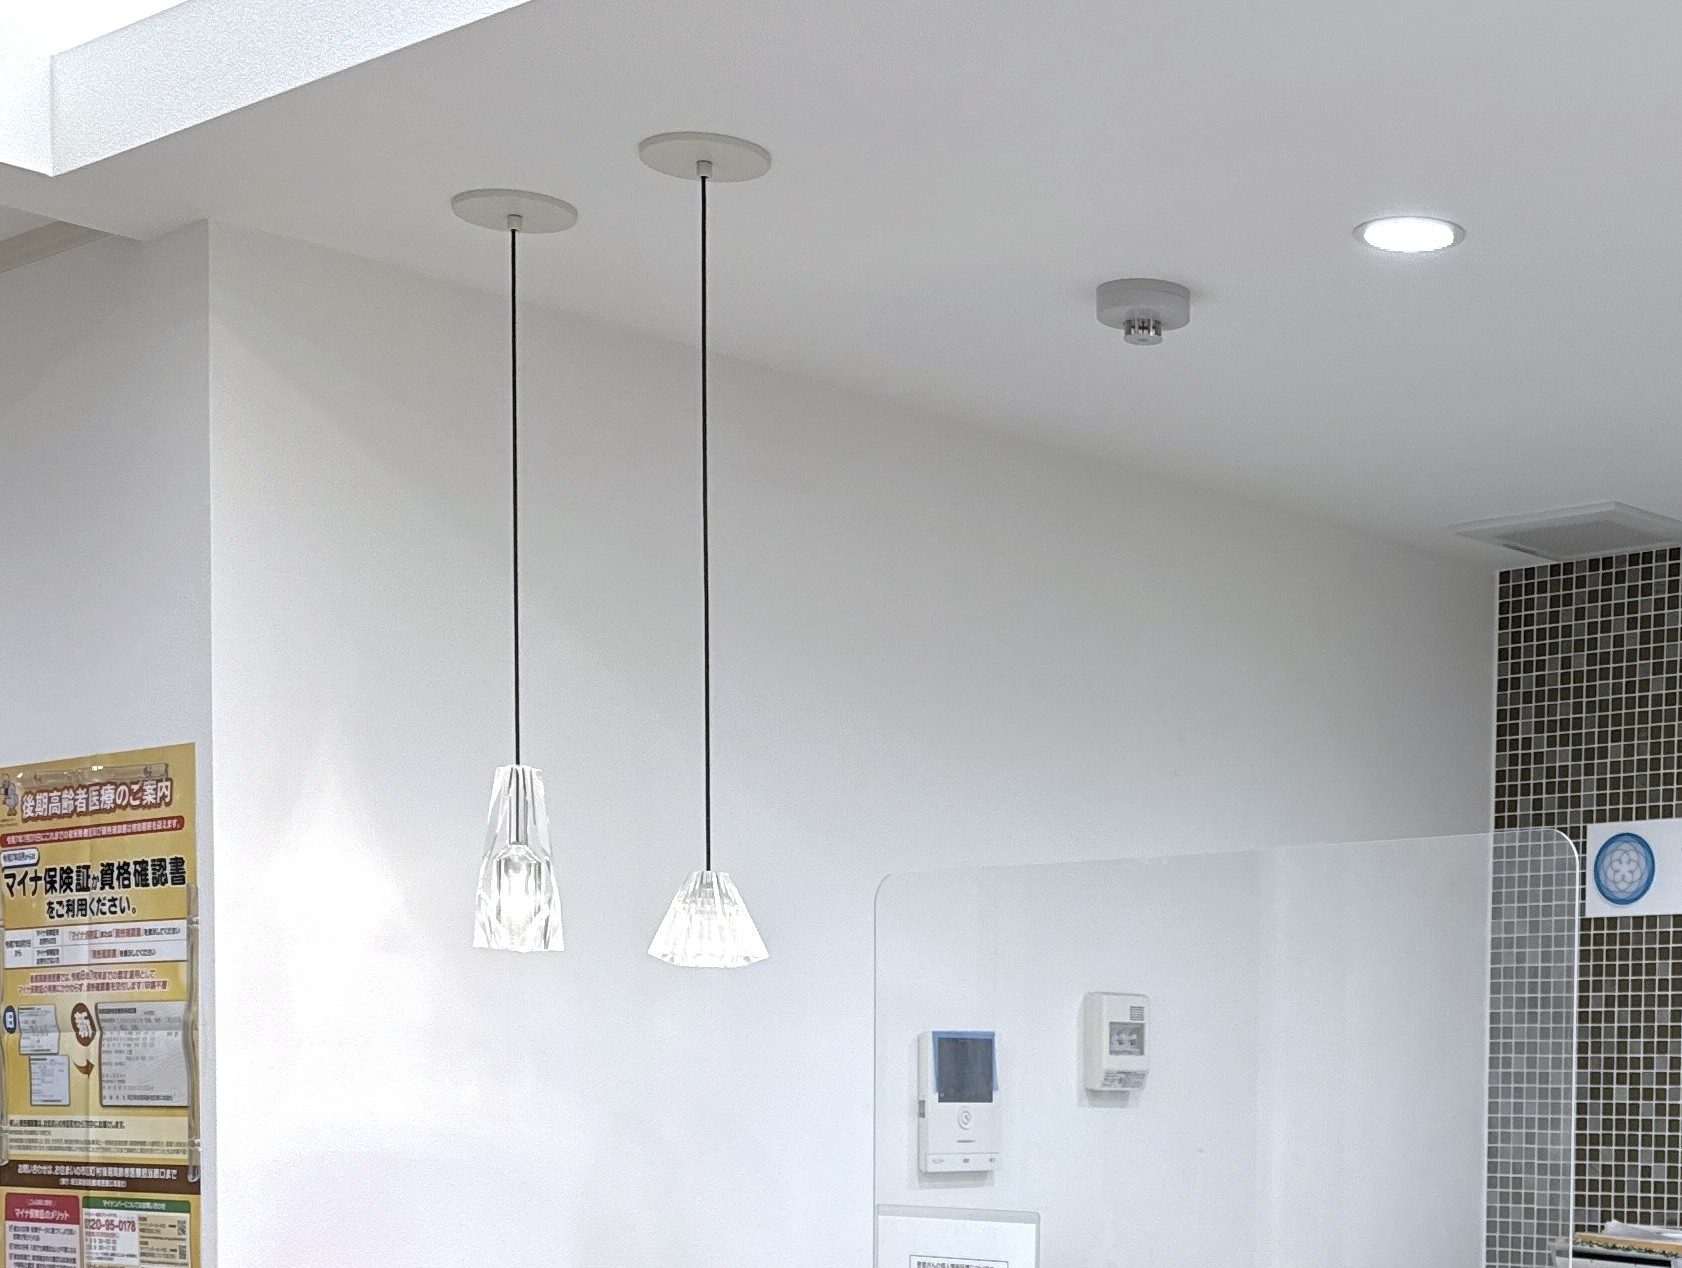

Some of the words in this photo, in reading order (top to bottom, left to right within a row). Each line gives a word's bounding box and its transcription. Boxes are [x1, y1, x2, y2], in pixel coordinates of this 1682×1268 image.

[21, 779, 171, 819] 後期高齢者医療のご案内
[4, 856, 187, 897] マイナ保険証か資格確認書
[46, 896, 137, 919] をご利用ください。
